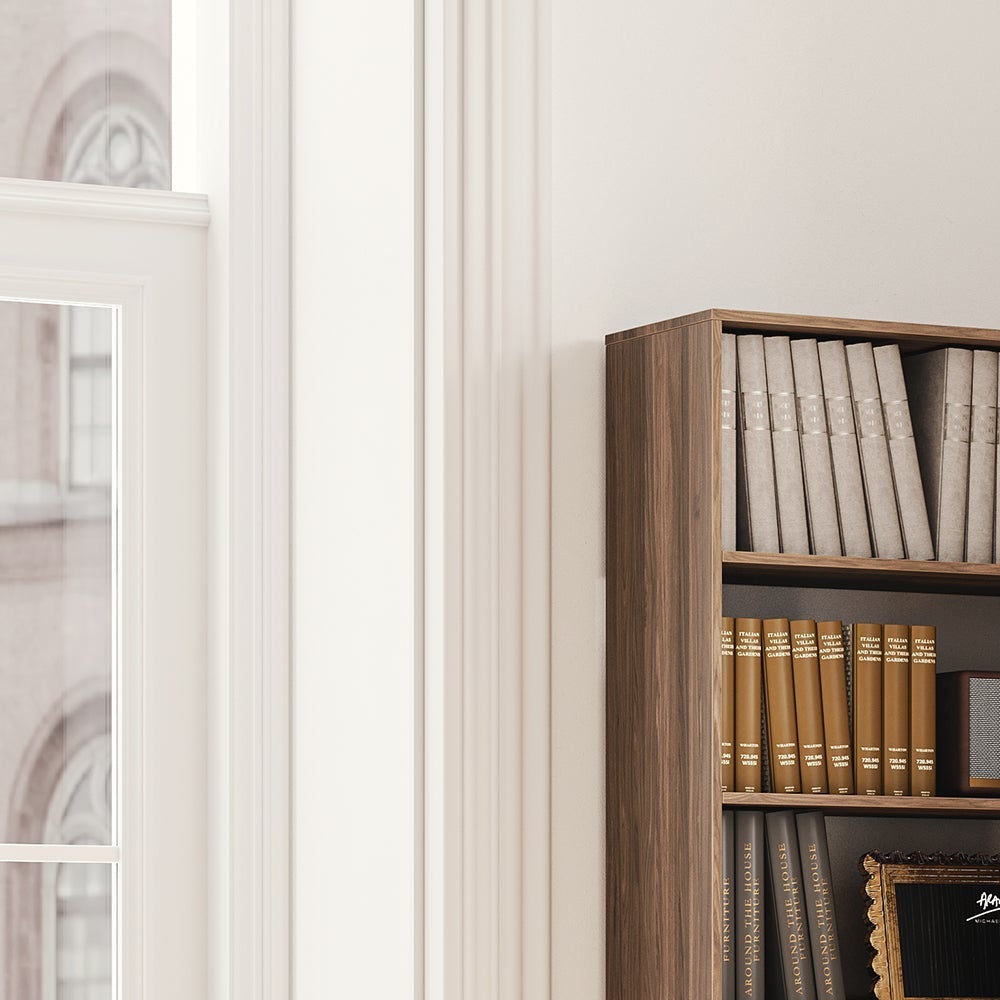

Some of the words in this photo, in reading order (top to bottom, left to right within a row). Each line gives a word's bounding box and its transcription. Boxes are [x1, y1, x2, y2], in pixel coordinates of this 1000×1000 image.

[744, 842, 753, 892] HOUSE
[778, 842, 792, 892] HOUSE
[808, 844, 821, 892] HOUSE
[787, 898, 796, 928] THE
[815, 899, 826, 928] THE
[744, 934, 753, 997] AROUND
[789, 932, 804, 995] AROUND
[819, 933, 834, 995] AROUND
